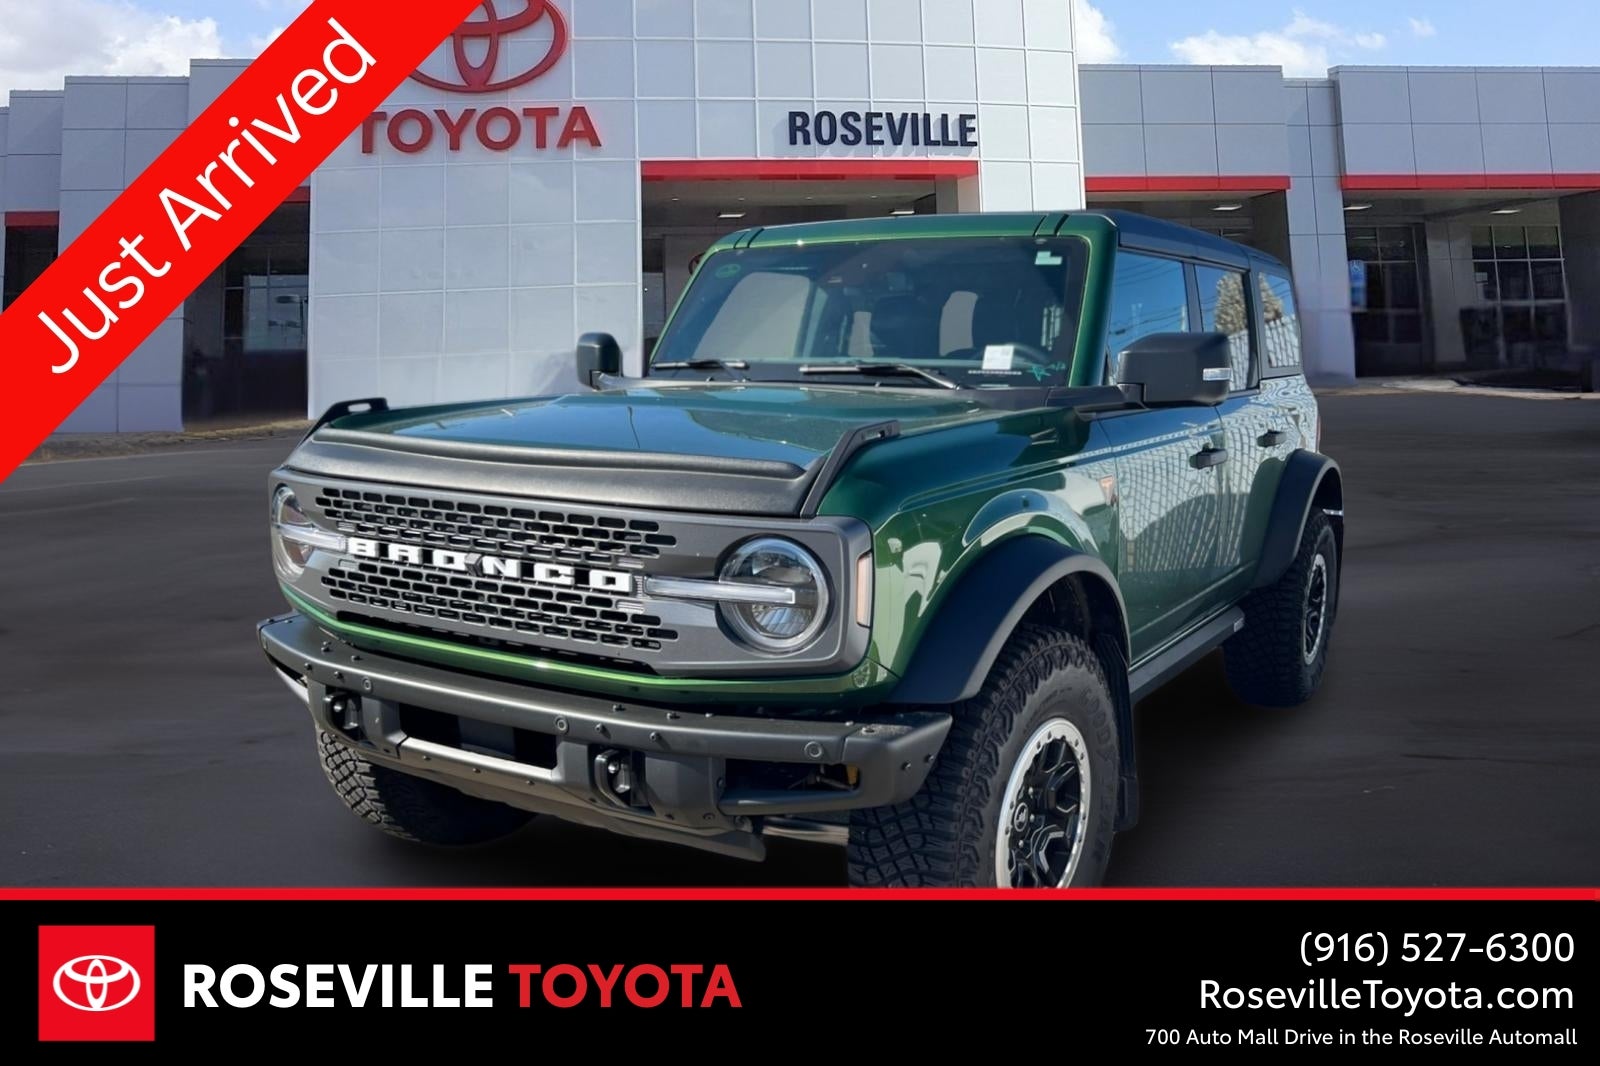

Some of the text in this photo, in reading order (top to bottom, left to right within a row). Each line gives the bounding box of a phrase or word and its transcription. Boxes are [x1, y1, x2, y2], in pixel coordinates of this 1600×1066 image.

[361, 106, 602, 154] TOYOTA
[788, 110, 978, 147] ROSEVILLE
[348, 536, 632, 593] BRONCO
